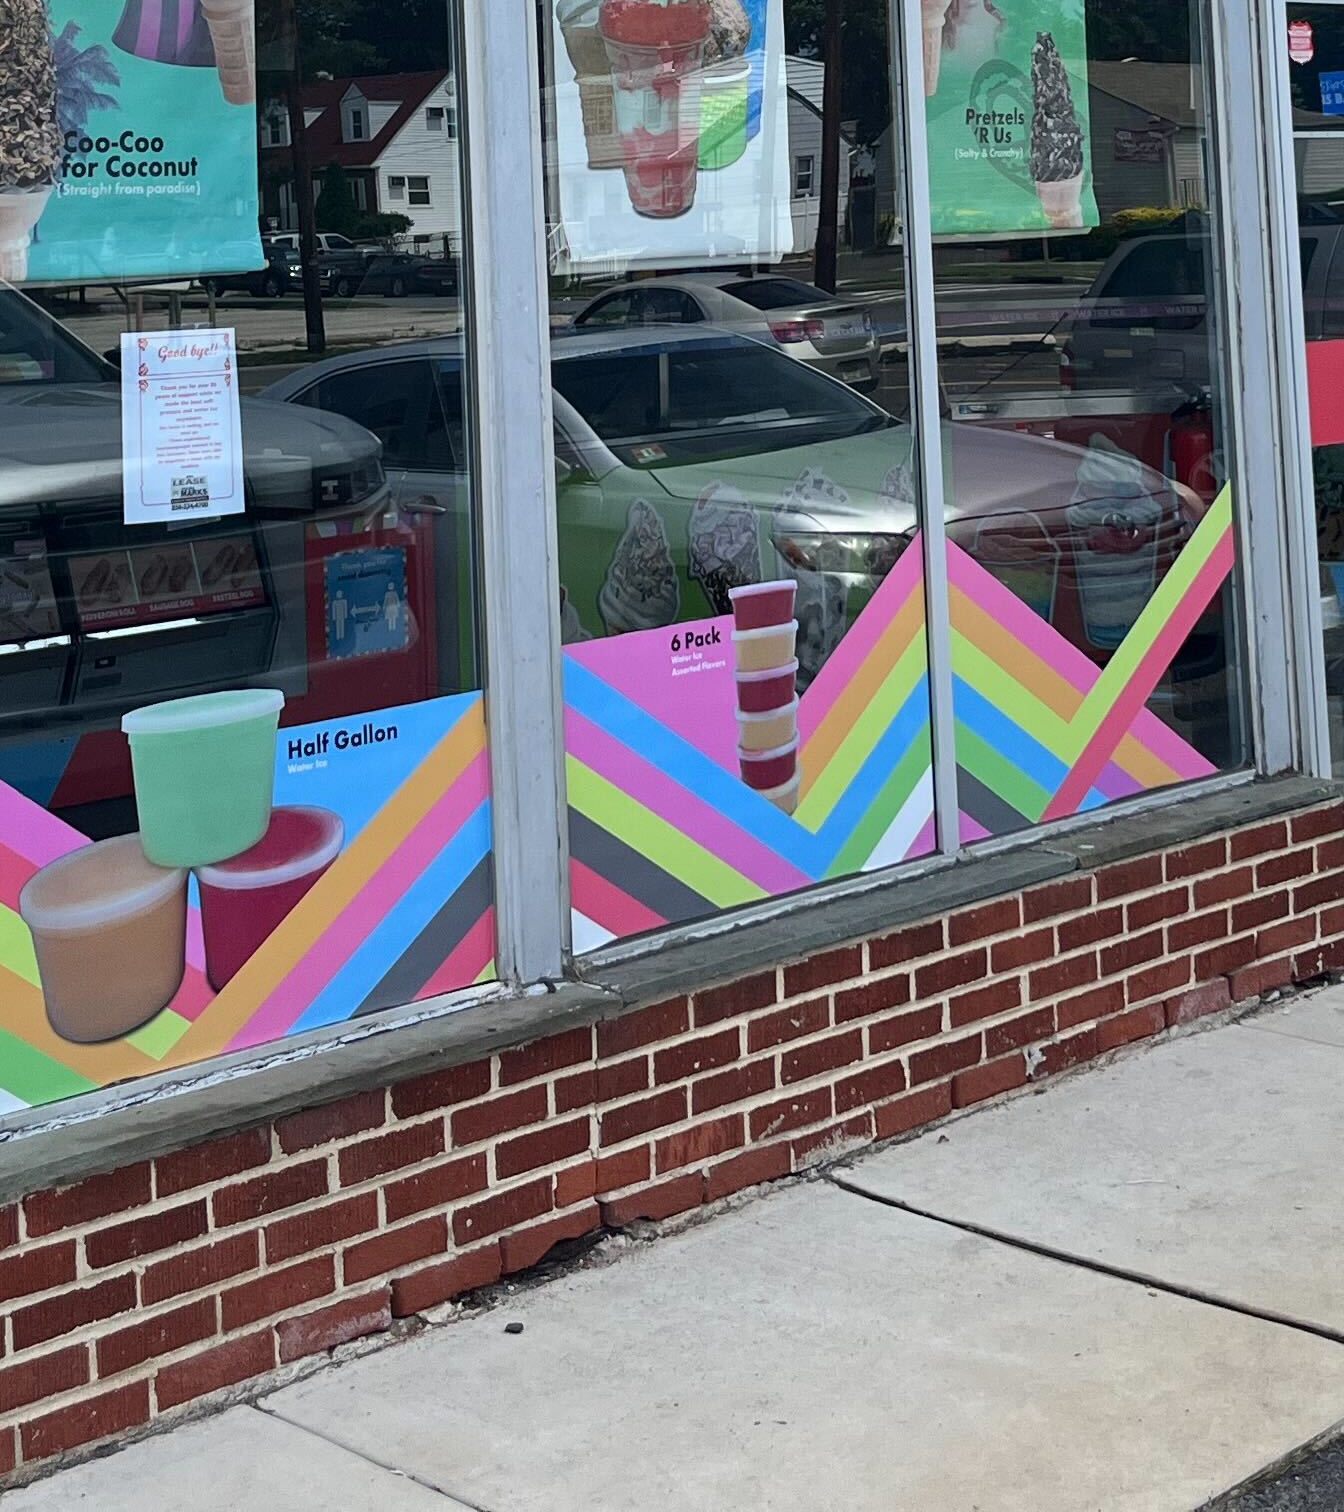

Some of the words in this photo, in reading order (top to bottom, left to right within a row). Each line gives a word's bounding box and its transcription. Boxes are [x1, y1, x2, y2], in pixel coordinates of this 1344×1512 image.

[965, 107, 1025, 127] Pretzels
[62, 131, 164, 153] Coo-Coo
[993, 126, 1012, 144] Us
[61, 155, 98, 178] for
[105, 156, 198, 178] Coconut
[115, 182, 144, 196] from
[158, 345, 187, 364] Good
[670, 634, 681, 652] 6
[685, 626, 721, 649] Pack
[288, 731, 329, 760] Half
[334, 723, 398, 751] Gallon
[287, 761, 313, 775] Water
[315, 759, 328, 769] Ice
